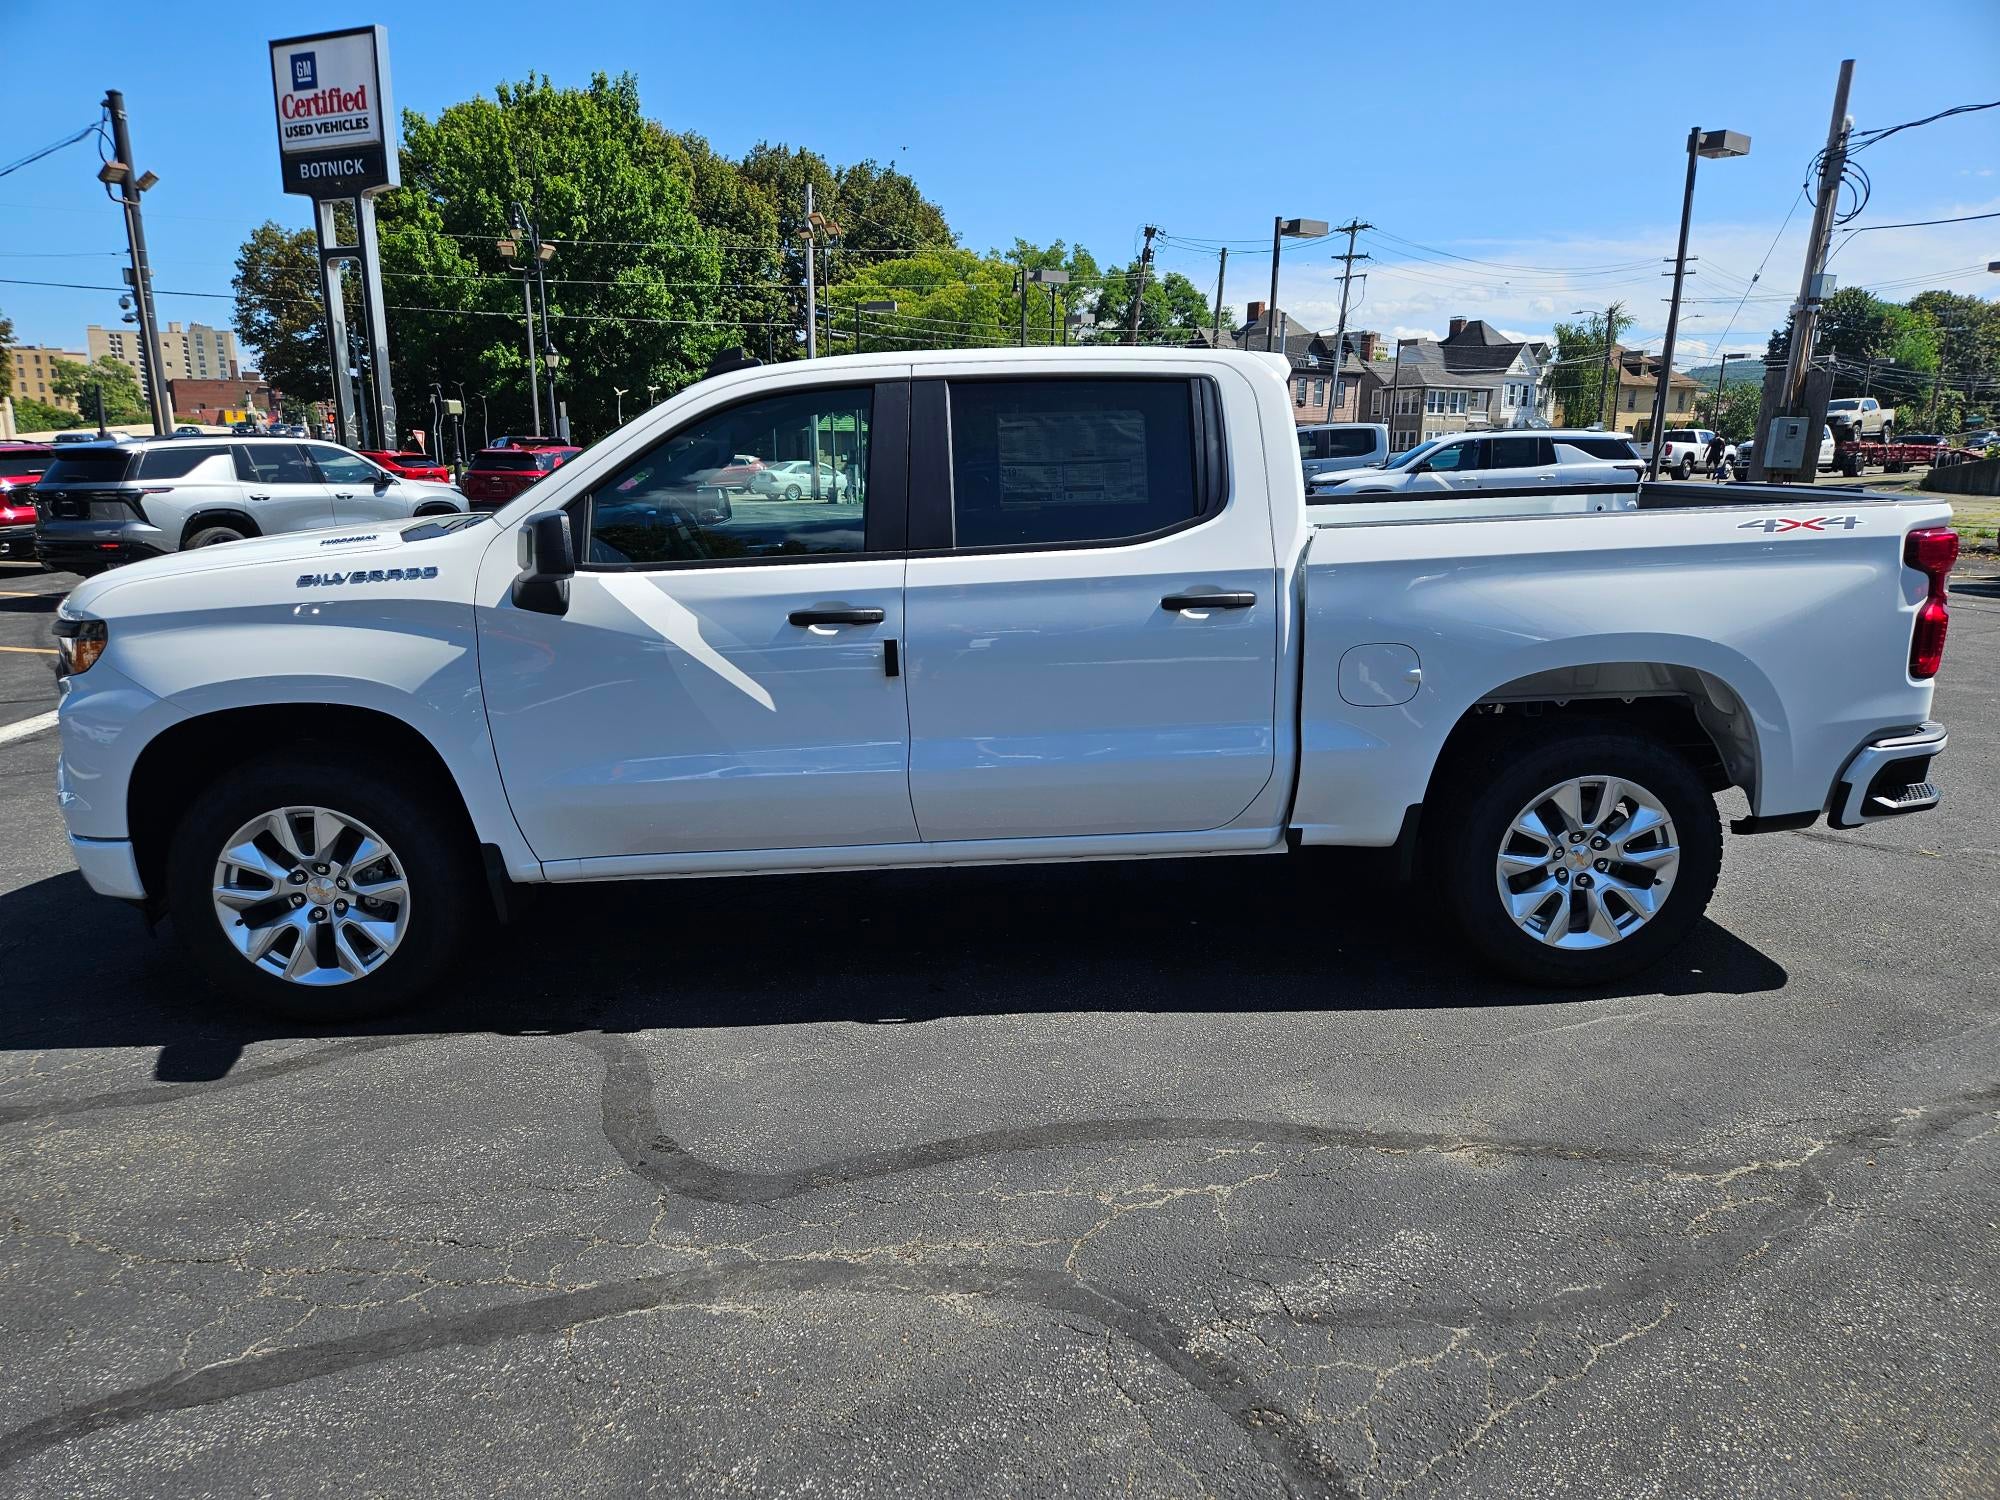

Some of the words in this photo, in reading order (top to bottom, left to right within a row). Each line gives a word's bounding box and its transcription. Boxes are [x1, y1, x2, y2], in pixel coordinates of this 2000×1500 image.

[296, 61, 312, 78] GM
[281, 85, 368, 120] Certified
[285, 123, 314, 138] USED
[315, 117, 369, 135] VEHICLES
[300, 159, 365, 179] BOTNICK
[296, 566, 439, 588] SILVERADO
